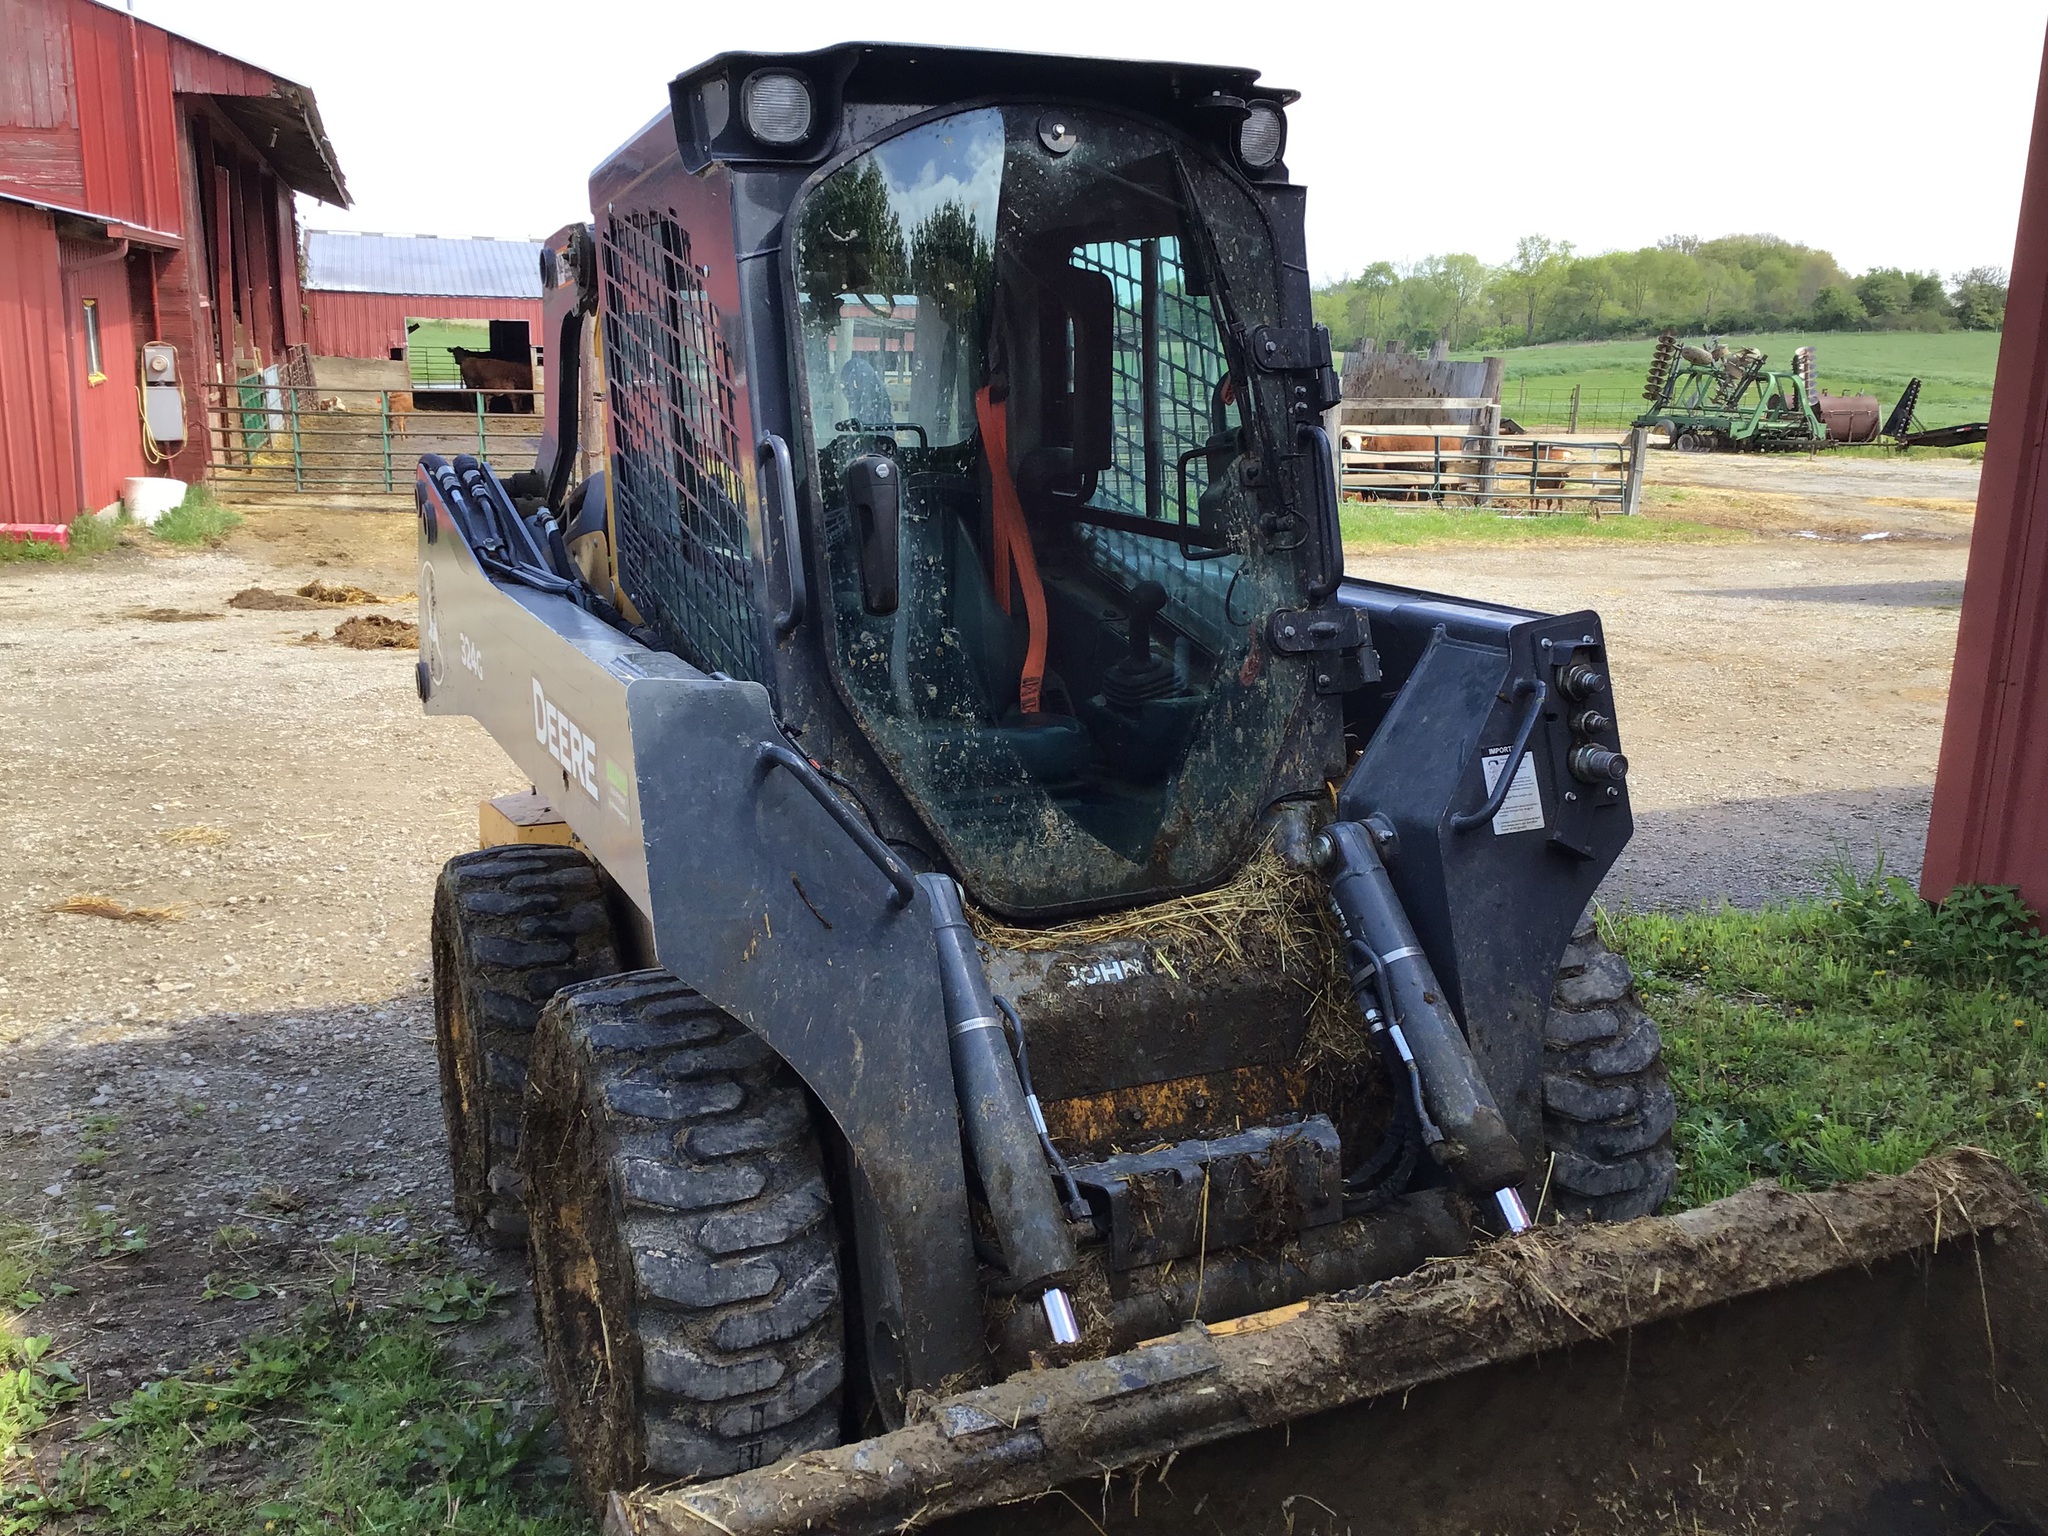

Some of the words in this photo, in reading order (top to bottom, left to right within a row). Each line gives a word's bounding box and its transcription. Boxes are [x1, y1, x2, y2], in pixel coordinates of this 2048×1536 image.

[459, 632, 484, 681] 324G
[532, 677, 599, 802] DEERE
[1488, 745, 1513, 755] IMPORT
